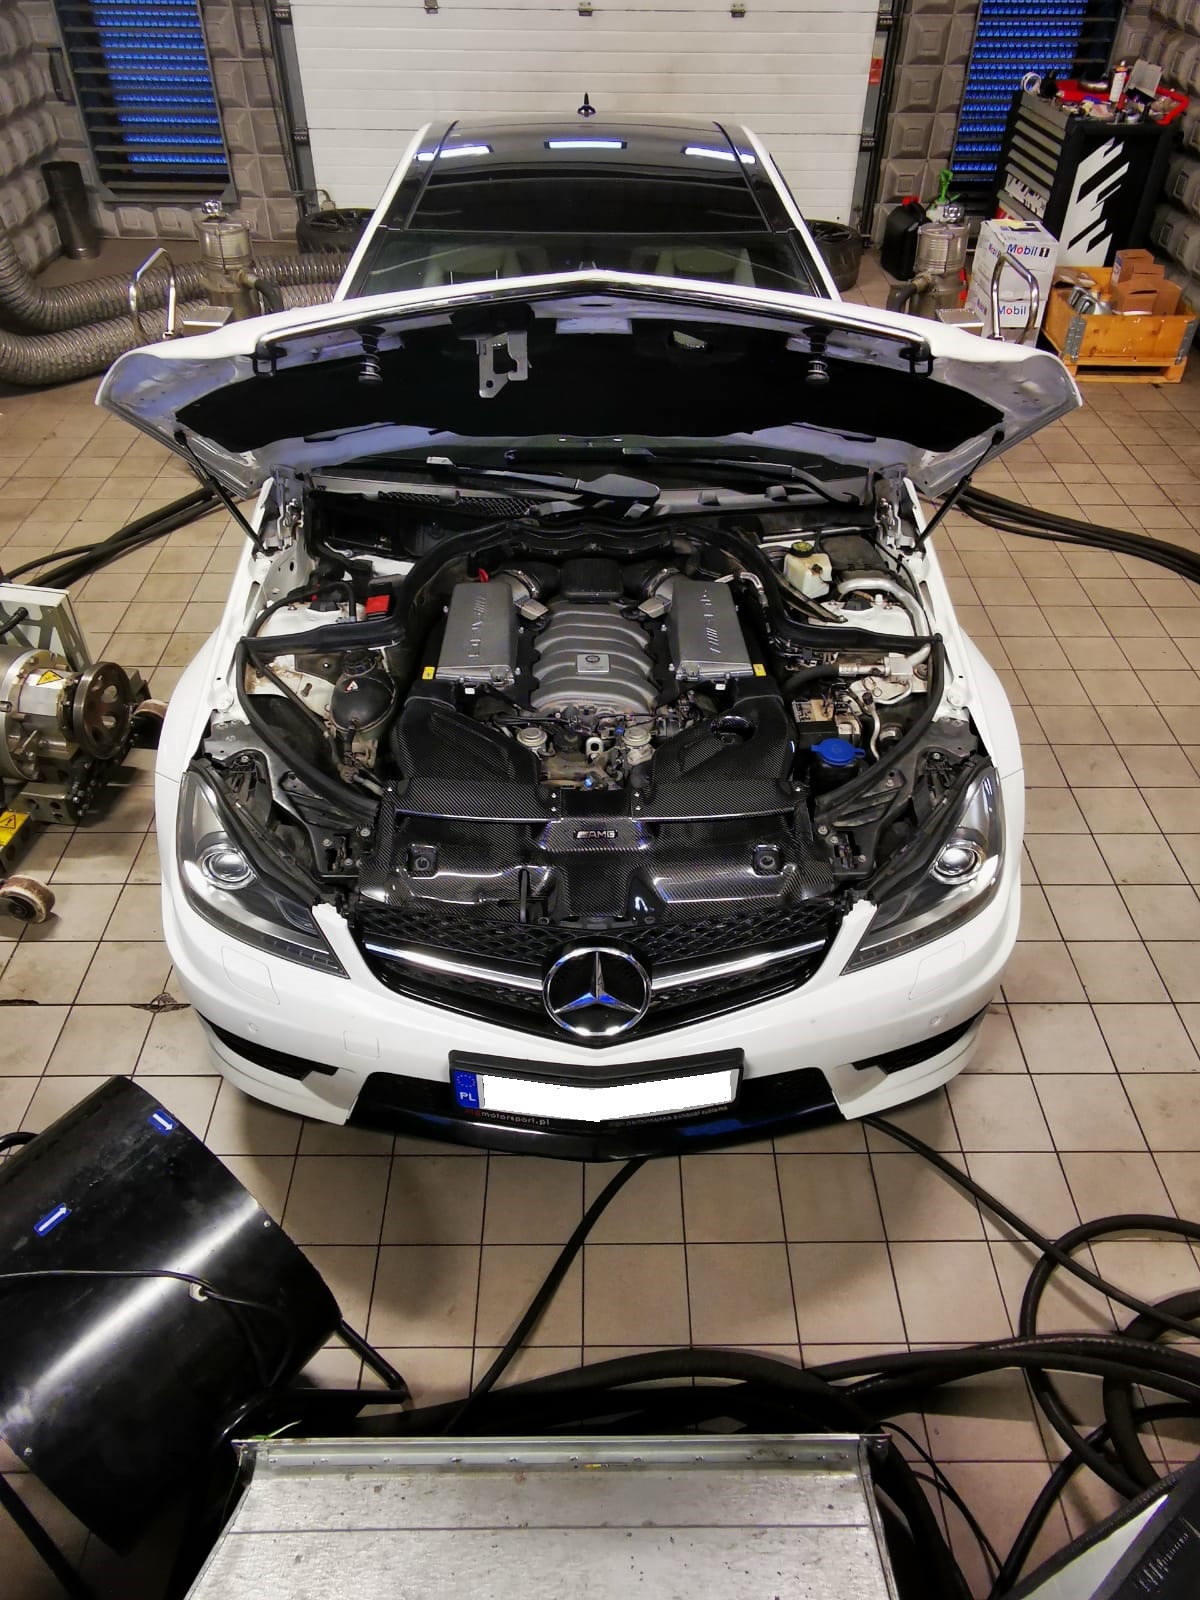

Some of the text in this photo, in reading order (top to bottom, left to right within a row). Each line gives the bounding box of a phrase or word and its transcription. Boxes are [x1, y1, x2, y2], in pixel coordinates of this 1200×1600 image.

[1007, 243, 1038, 257] Mobil
[1039, 247, 1050, 258] 1
[587, 830, 615, 838] AMG
[460, 1092, 477, 1102] PL
